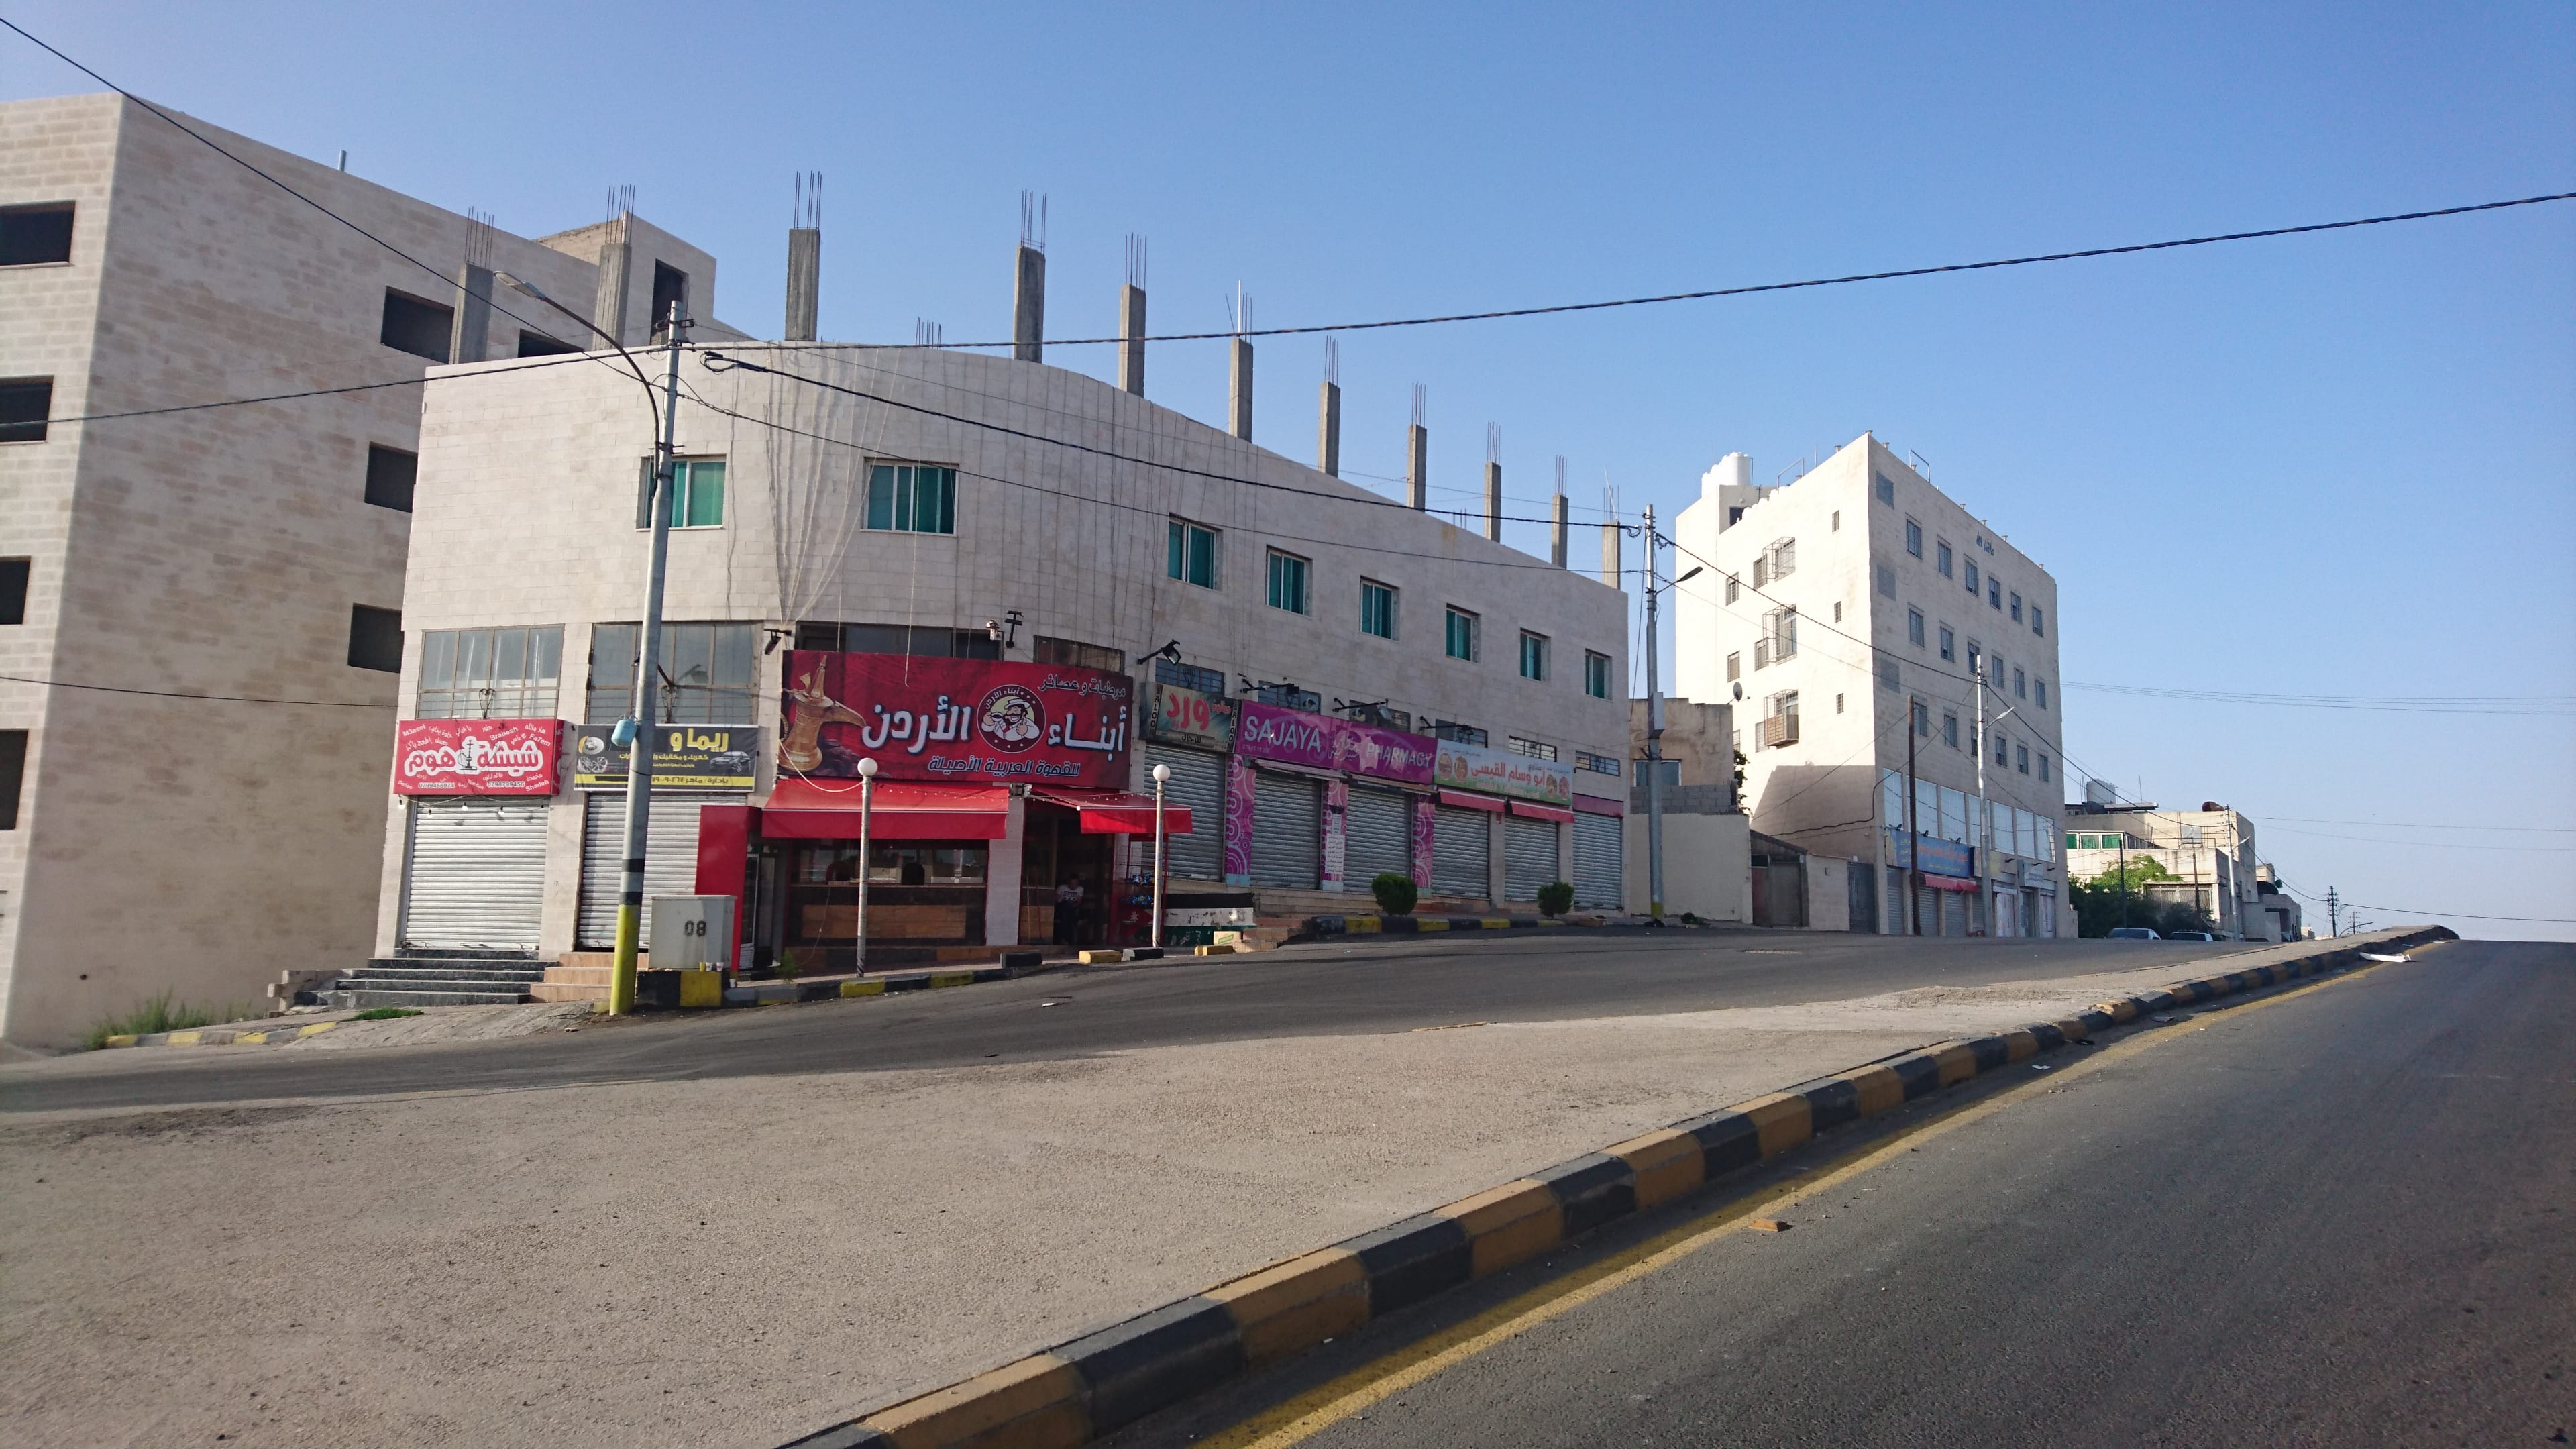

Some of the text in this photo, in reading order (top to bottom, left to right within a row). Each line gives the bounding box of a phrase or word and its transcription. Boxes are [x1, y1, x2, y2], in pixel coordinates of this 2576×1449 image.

[1004, 687, 1020, 695] أبناء
[1038, 674, 1126, 700] مرطبات و عصائر
[1167, 693, 1210, 731] ورد
[687, 728, 729, 752] ريما
[862, 696, 1126, 761] أبناء الأردن
[1245, 716, 1321, 753] SAJAYA
[1366, 742, 1433, 769] PHARMACY
[406, 749, 457, 774] هوم
[928, 755, 1081, 777] للقهوة العربية الأصيلة
[684, 920, 707, 937] 08
